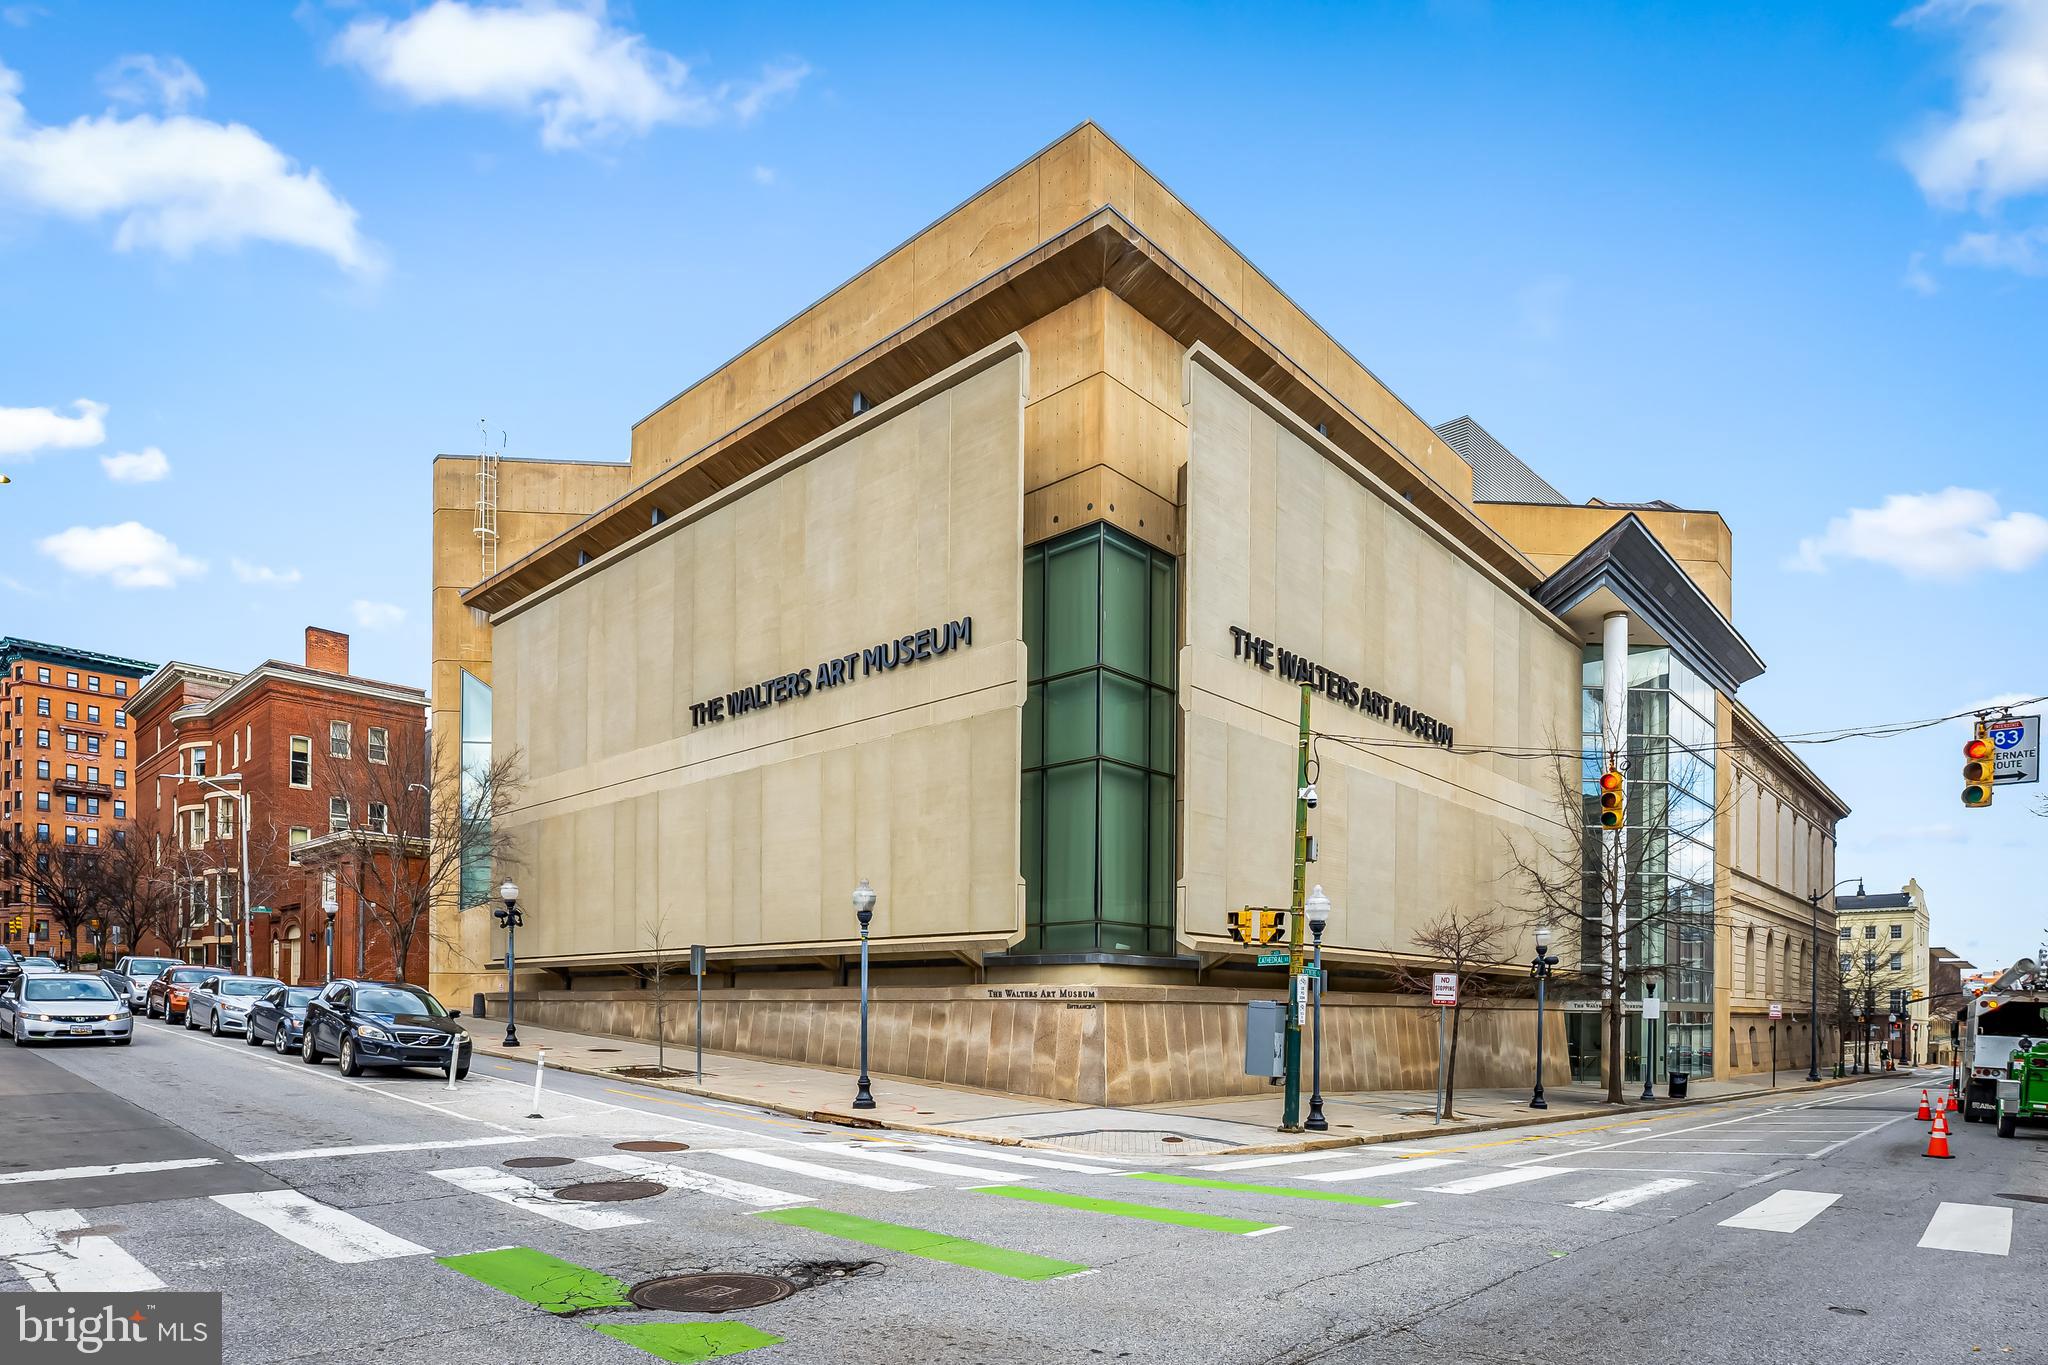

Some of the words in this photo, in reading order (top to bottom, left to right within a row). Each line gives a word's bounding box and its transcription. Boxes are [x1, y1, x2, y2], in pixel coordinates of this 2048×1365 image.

[689, 697, 725, 727] THE
[726, 668, 812, 716] WALTERS
[815, 652, 859, 690] ART
[862, 616, 972, 676] MUSEUM
[1229, 625, 1274, 671] THE
[1277, 647, 1359, 708] WALTERS
[1359, 687, 1392, 722] ART
[1393, 702, 1453, 748] MUSEUM
[1995, 731, 2018, 745] 83
[1994, 750, 2036, 760] ERNATE
[1258, 955, 1283, 963] CATHEDRAL
